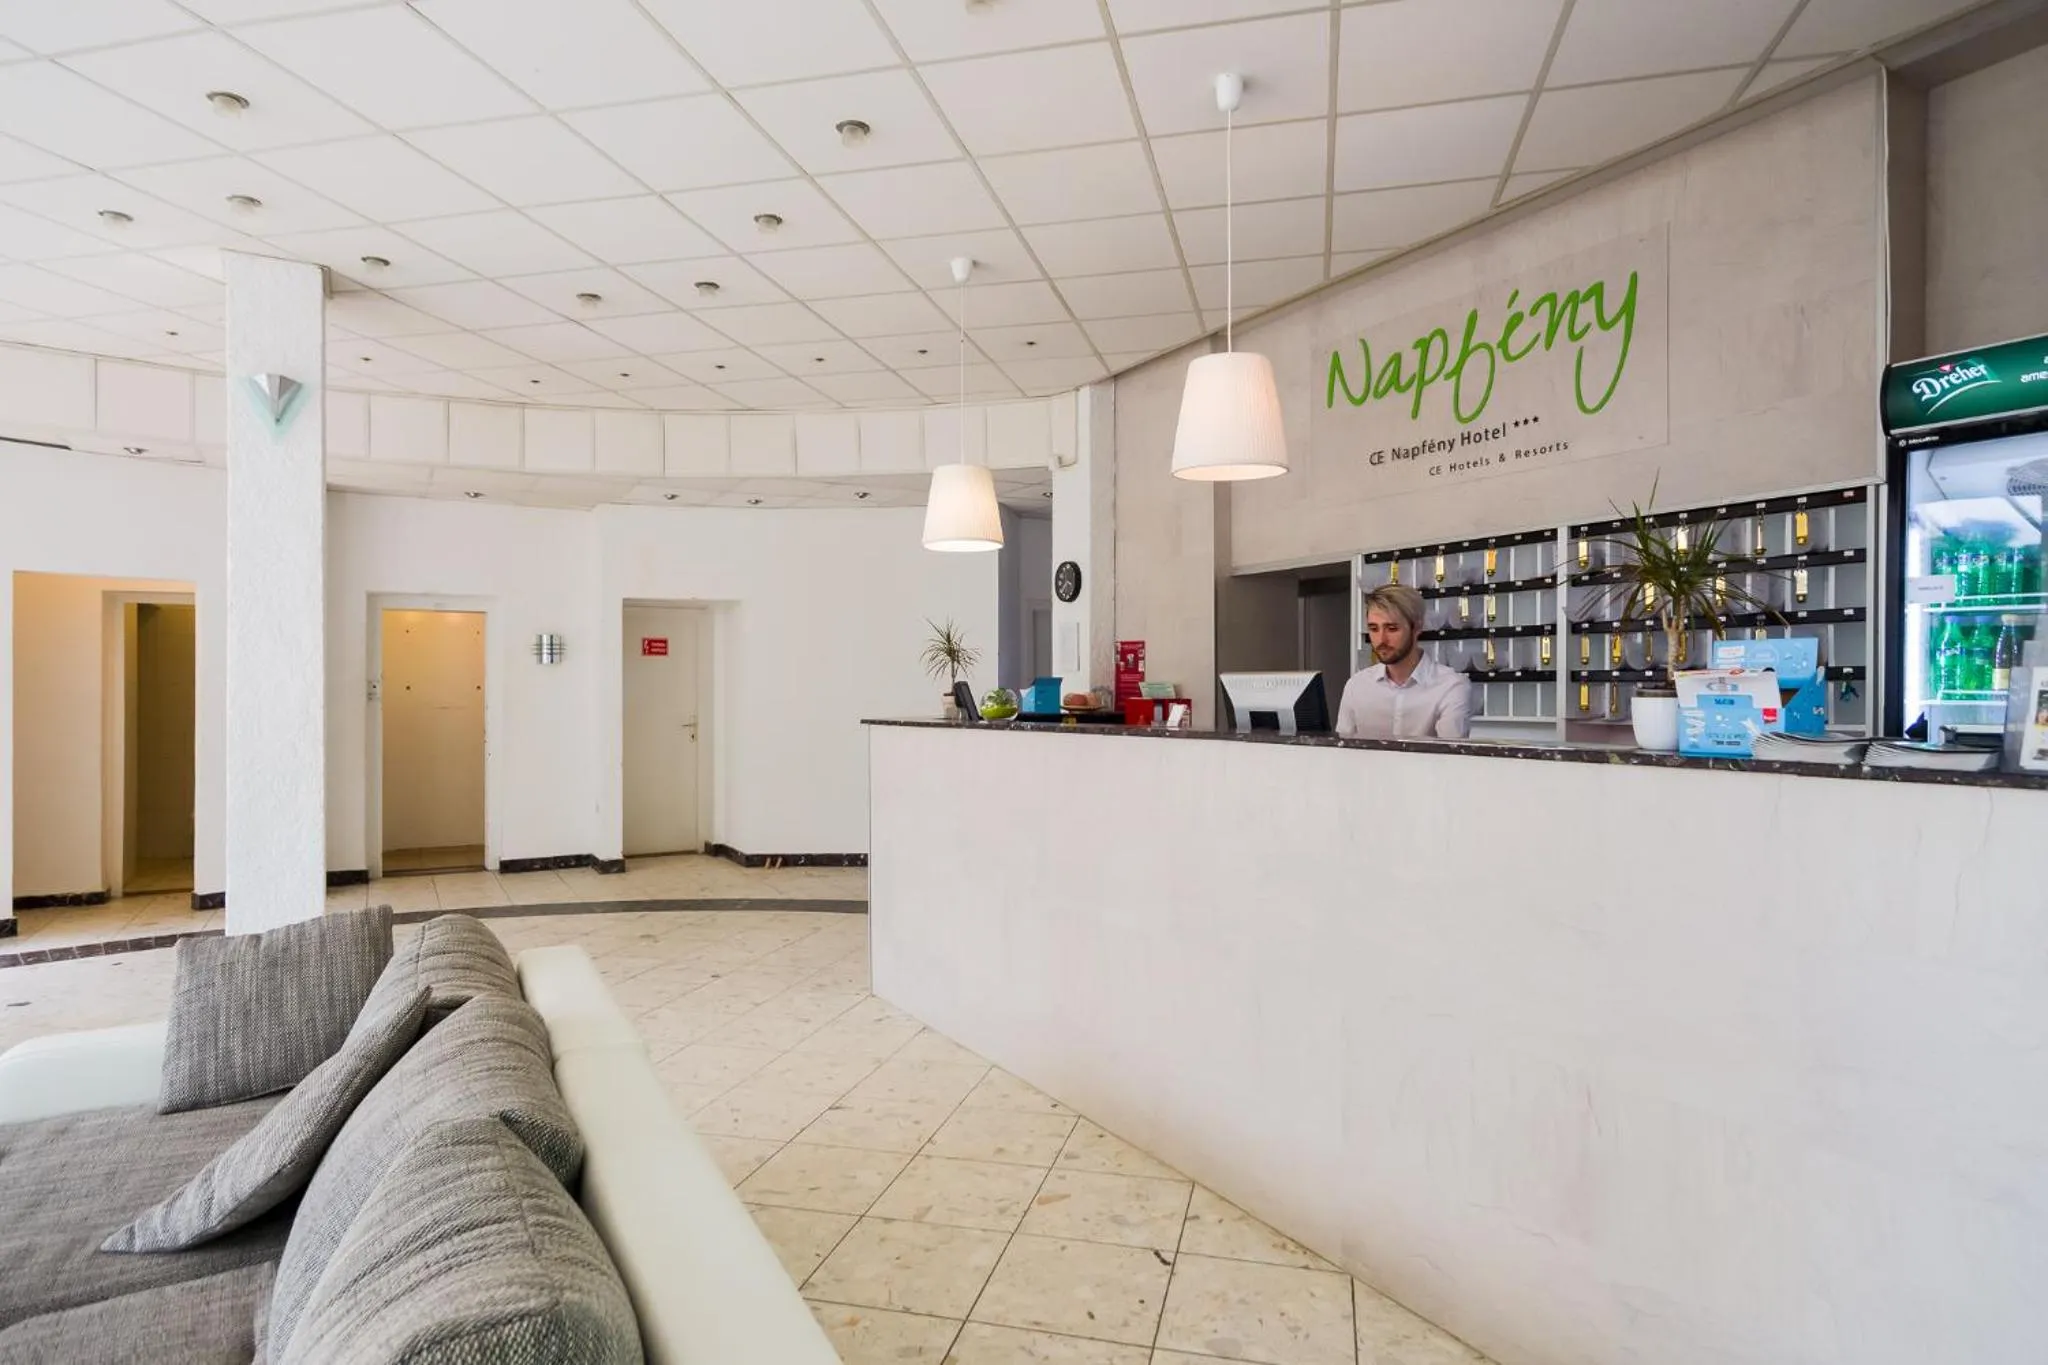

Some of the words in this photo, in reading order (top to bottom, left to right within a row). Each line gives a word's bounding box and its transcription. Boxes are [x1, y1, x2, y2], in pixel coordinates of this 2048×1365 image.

[1327, 270, 1638, 424] Napfény
[1912, 363, 1988, 402] Dreher
[1391, 437, 1456, 461] Napfény
[1460, 422, 1507, 447] Hotel
[1449, 456, 1490, 473] Hotels
[1498, 453, 1506, 463] &
[1515, 441, 1569, 460] Resorts
